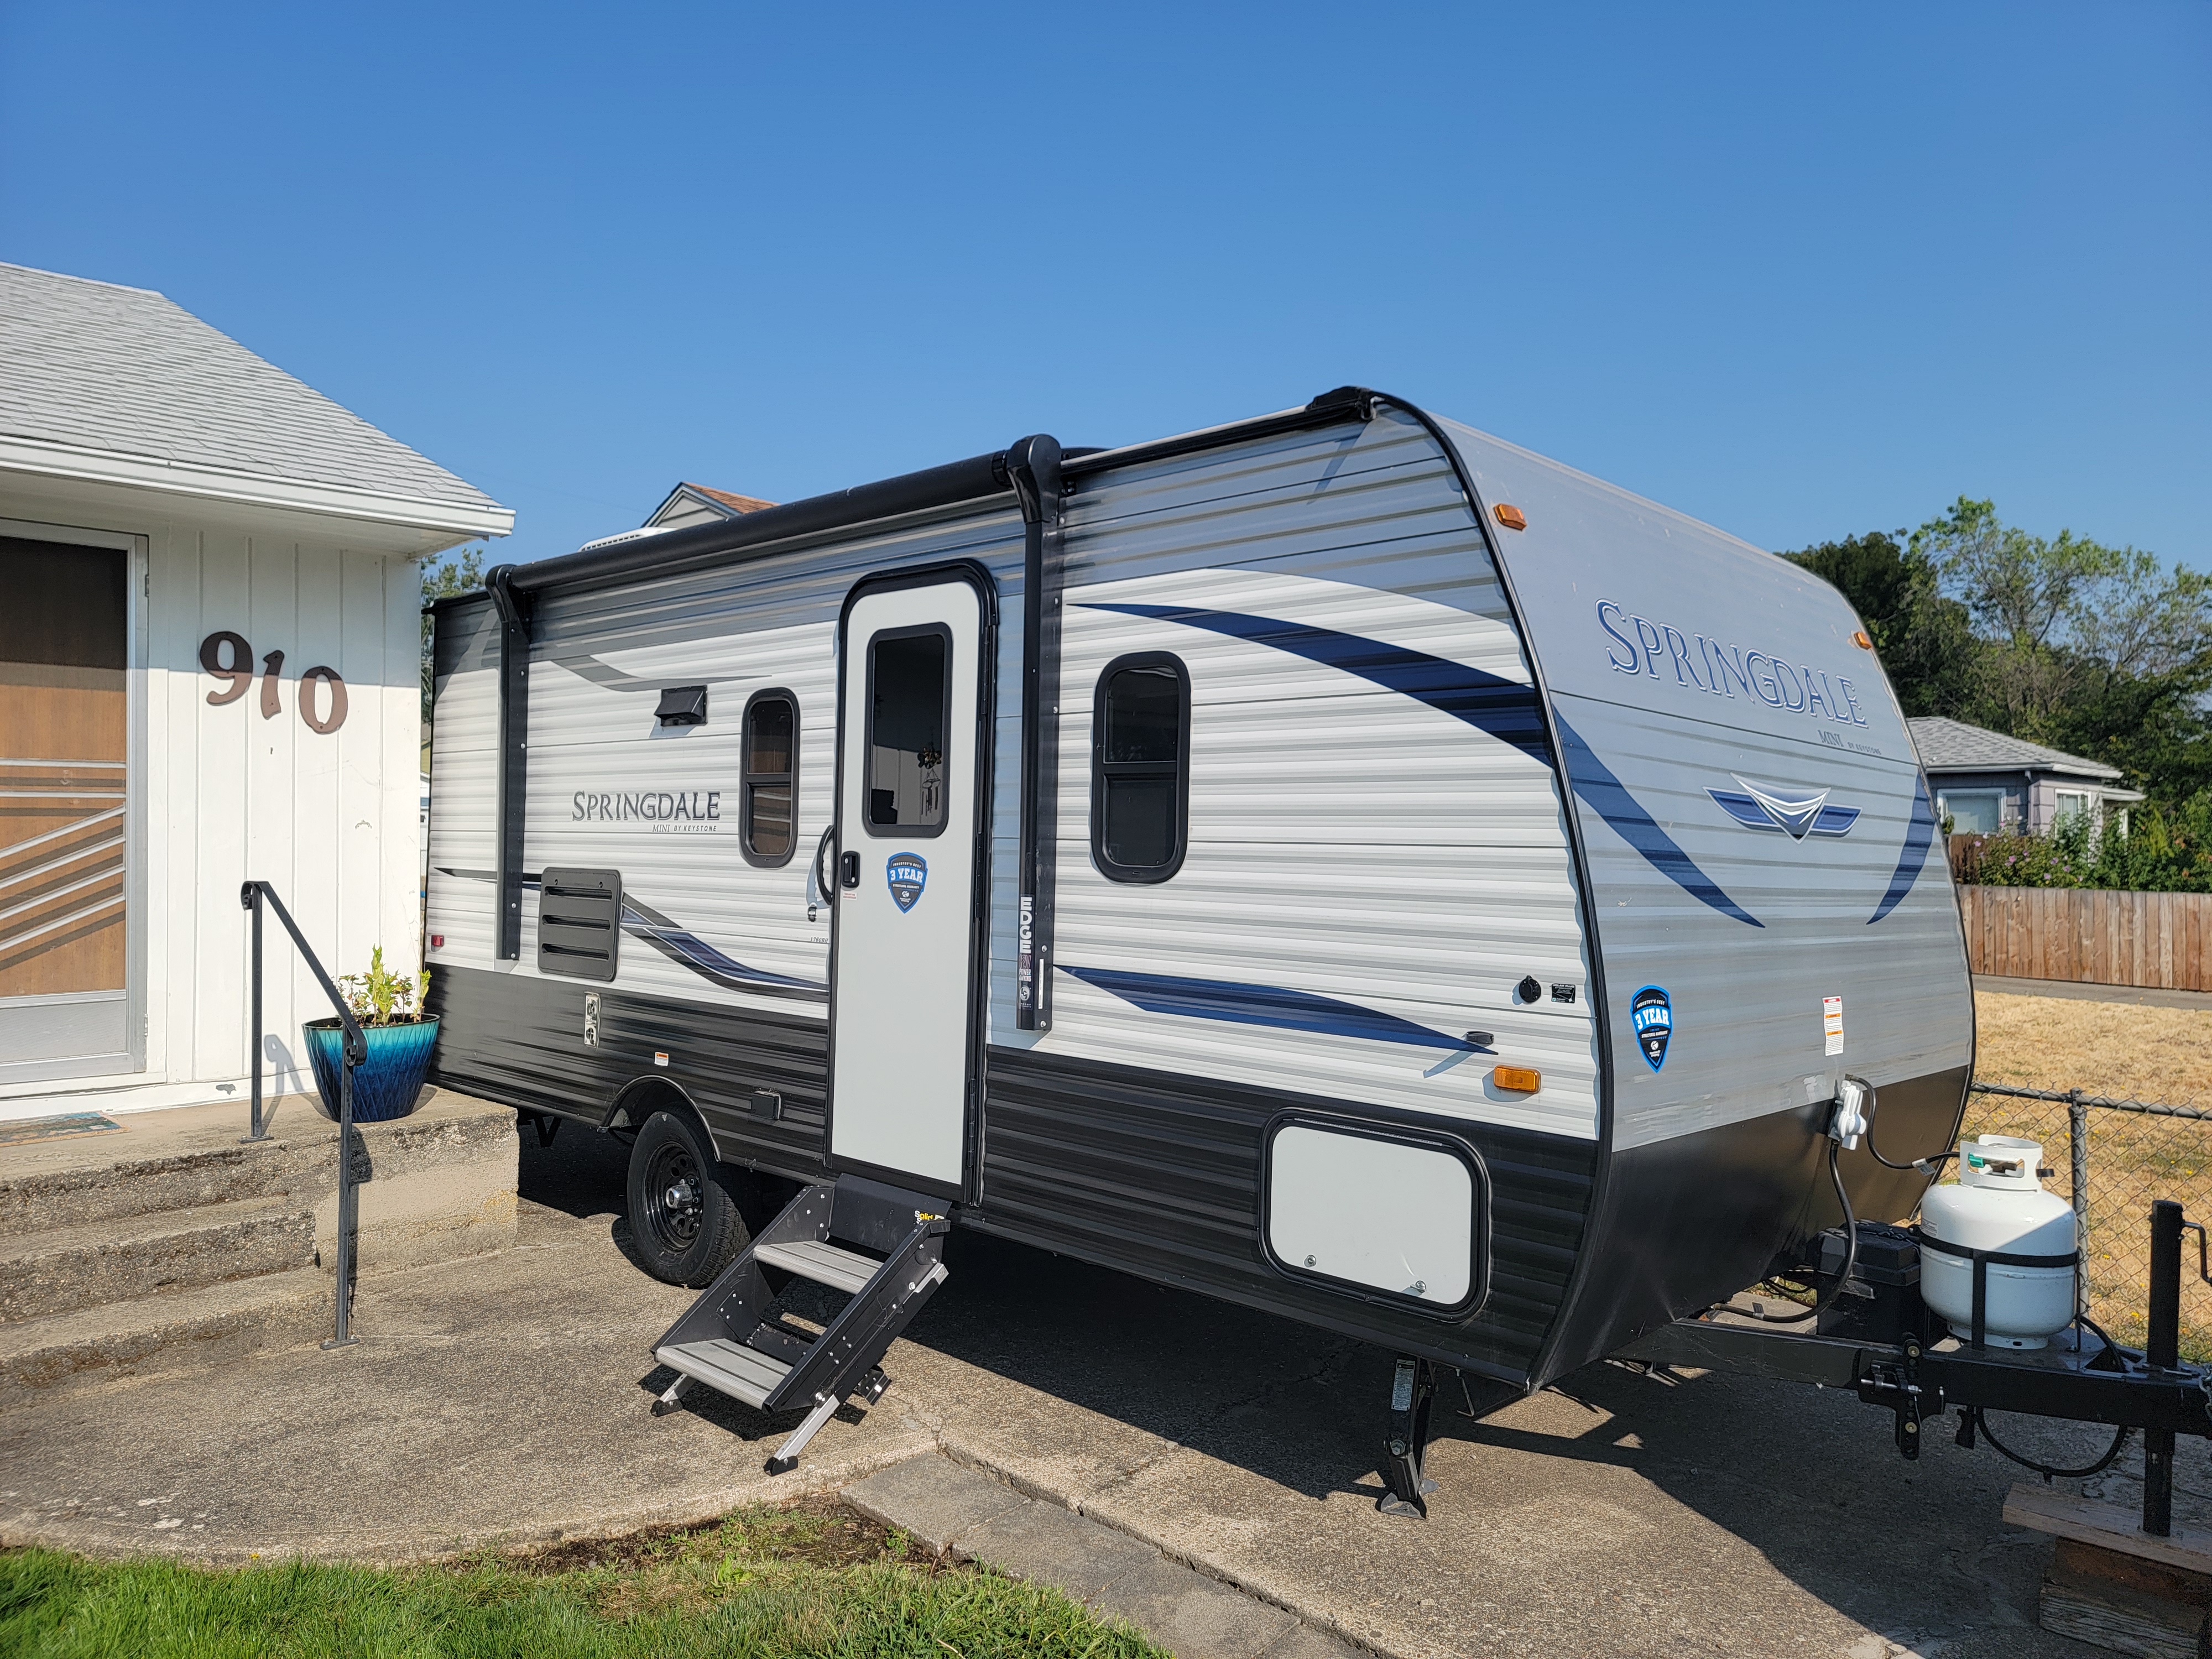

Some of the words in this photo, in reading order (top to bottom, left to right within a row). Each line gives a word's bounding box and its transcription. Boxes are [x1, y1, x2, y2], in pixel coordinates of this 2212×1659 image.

[1595, 598, 1869, 728] SPRINGDALE
[200, 631, 348, 735] 910
[1818, 729, 1844, 748] MINI
[571, 790, 721, 822] SPRINGDALE
[652, 824, 671, 832] MINI
[890, 869, 896, 881] 3
[898, 868, 924, 883] YEAR
[1019, 896, 1032, 954] EDGE
[1019, 954, 1031, 969] 12V
[1635, 1014, 1644, 1030] 3
[1642, 1008, 1670, 1025] YEAR
